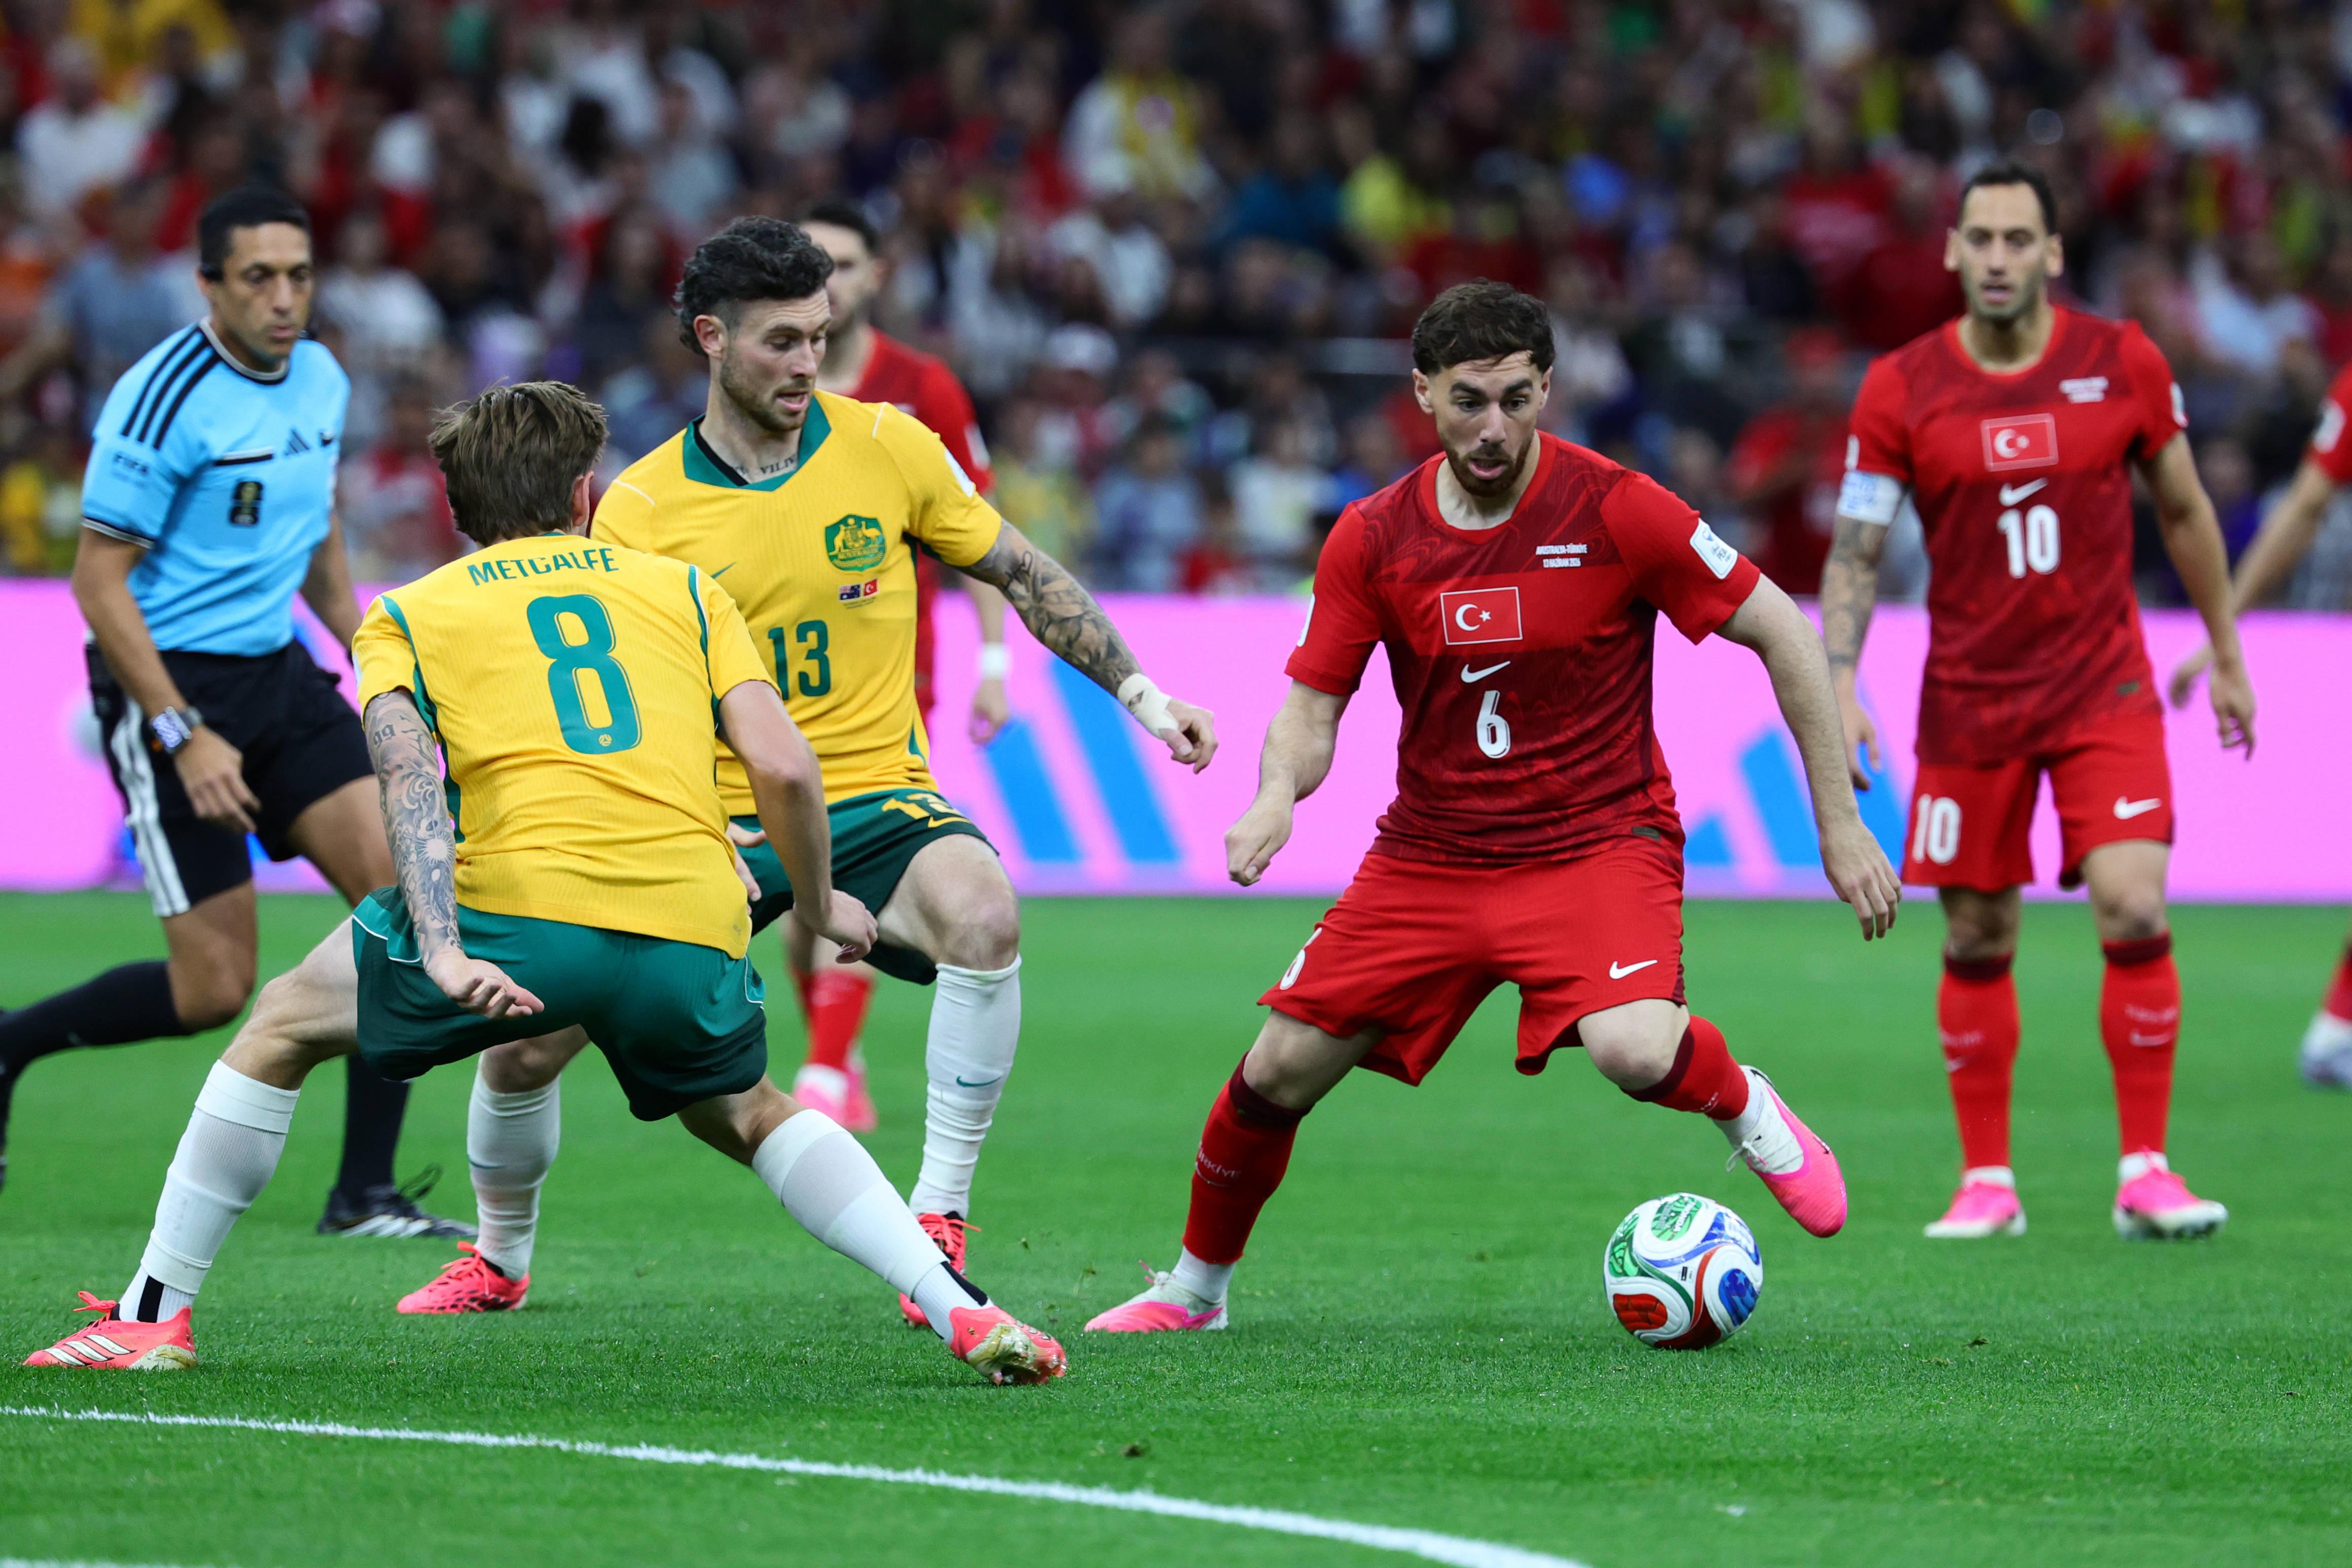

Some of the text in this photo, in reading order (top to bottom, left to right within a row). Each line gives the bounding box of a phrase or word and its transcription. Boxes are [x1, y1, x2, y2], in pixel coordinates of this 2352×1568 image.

[467, 548, 619, 586] METCALFE
[1998, 504, 2061, 578] 10
[526, 594, 642, 754] 8
[768, 619, 831, 701] 13
[1476, 690, 1510, 758] 6
[1913, 793, 1961, 865] 10
